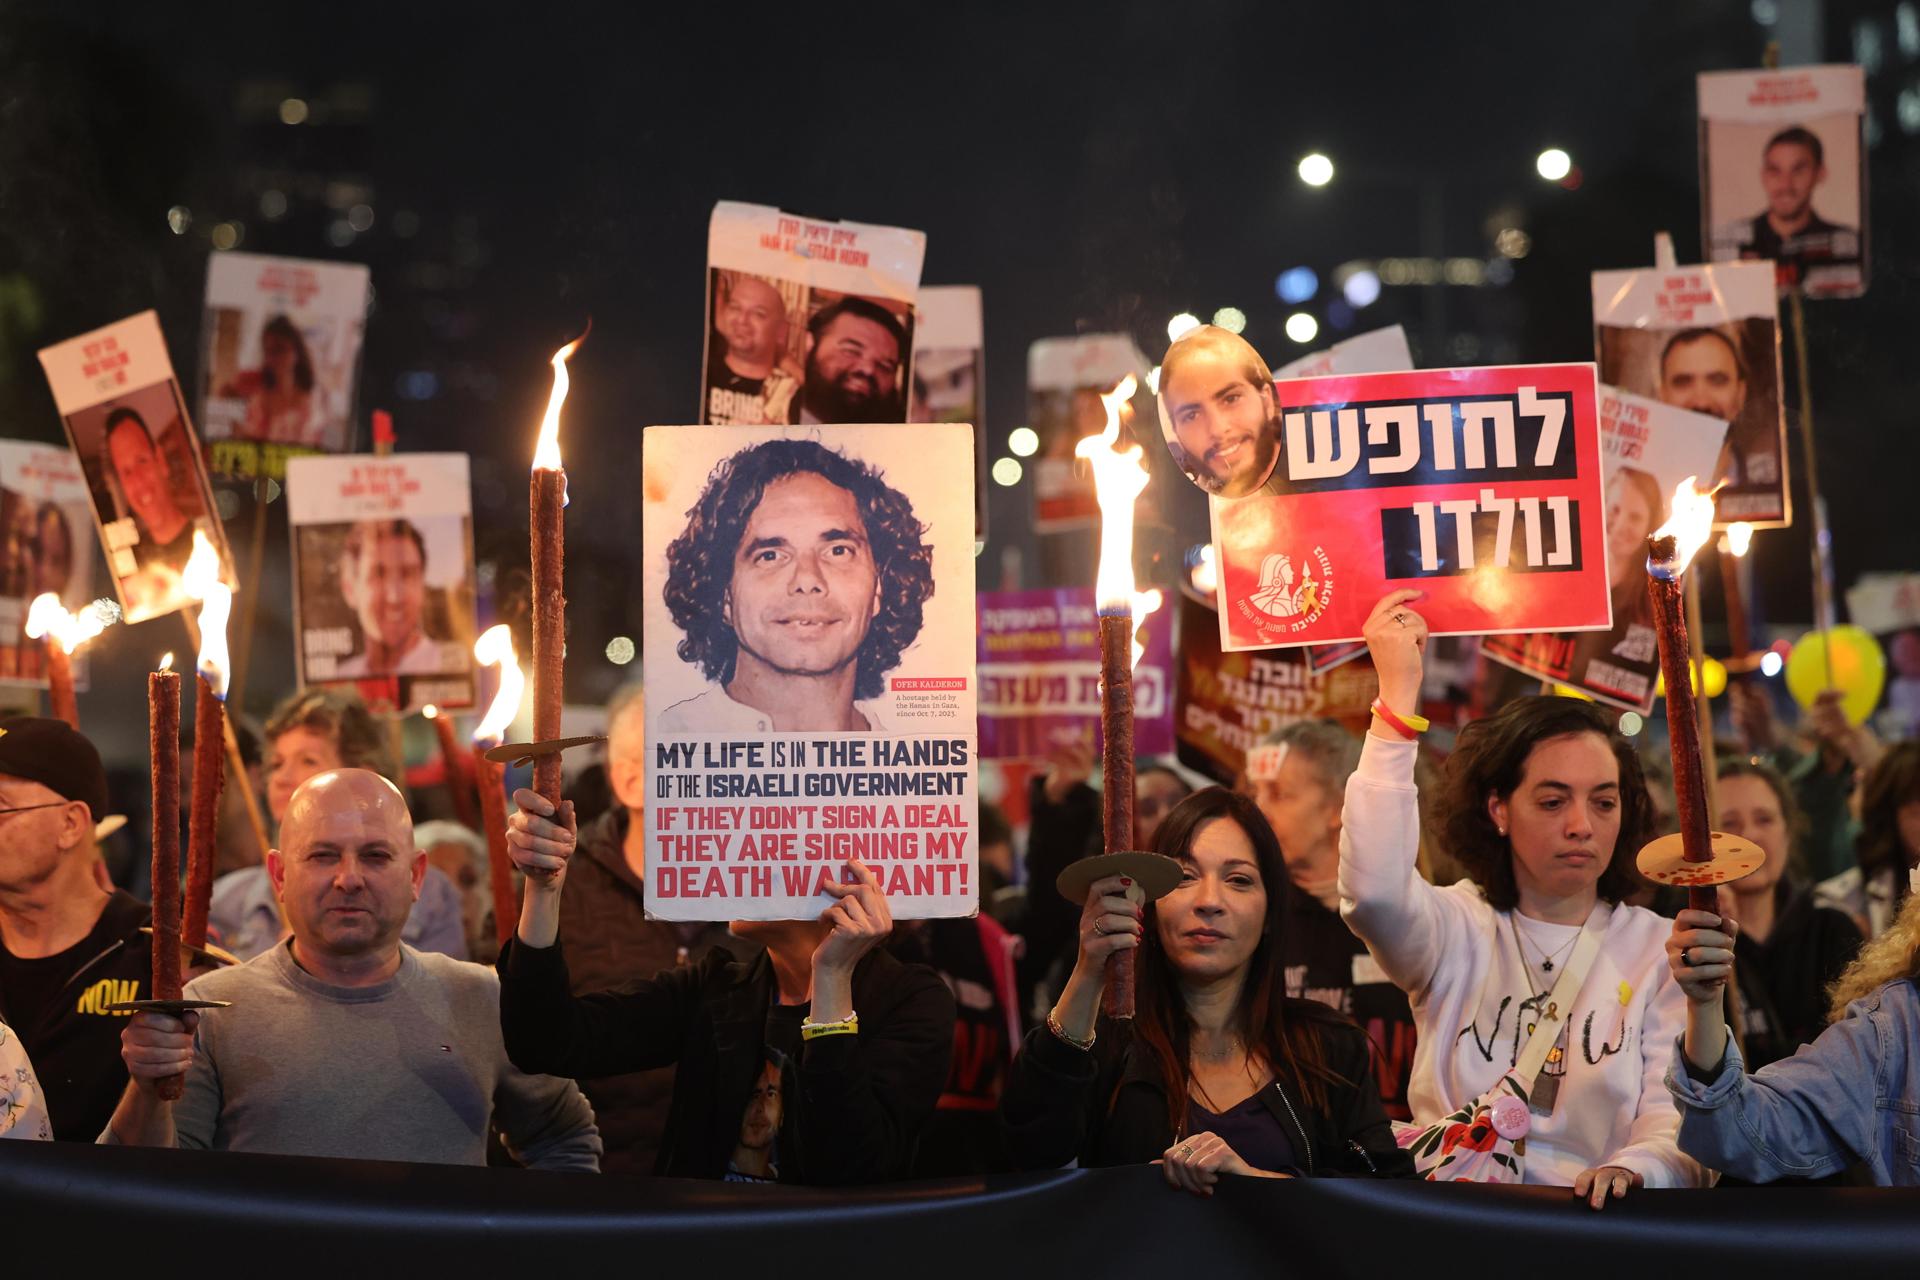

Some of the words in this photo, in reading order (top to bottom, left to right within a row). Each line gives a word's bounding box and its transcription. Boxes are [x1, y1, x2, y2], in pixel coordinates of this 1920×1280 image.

[710, 387, 764, 423] BRING
[1285, 386, 1566, 481] לחופש
[1413, 489, 1573, 571] נולדו
[902, 694, 929, 702] hostage
[948, 694, 956, 702] by
[657, 742, 697, 768] MY
[704, 741, 764, 768] LIFE
[771, 741, 785, 767] IS
[791, 741, 805, 767] IN
[812, 741, 866, 767] THE
[873, 740, 968, 766] HANDS
[657, 775, 673, 798] OF
[676, 775, 700, 798] THE
[706, 773, 799, 797] ISRAELI
[805, 772, 968, 796] GOVERNMENT
[657, 807, 679, 830] IF
[683, 806, 745, 830] THEY
[750, 806, 817, 829] DON'T
[822, 805, 876, 828] SIGN
[881, 805, 899, 828] A
[904, 805, 968, 828] DEAL
[657, 834, 732, 862] THEY
[737, 834, 798, 861] ARE
[804, 833, 918, 861] SIGNING
[926, 832, 968, 859] MY
[656, 866, 772, 898] DEATH
